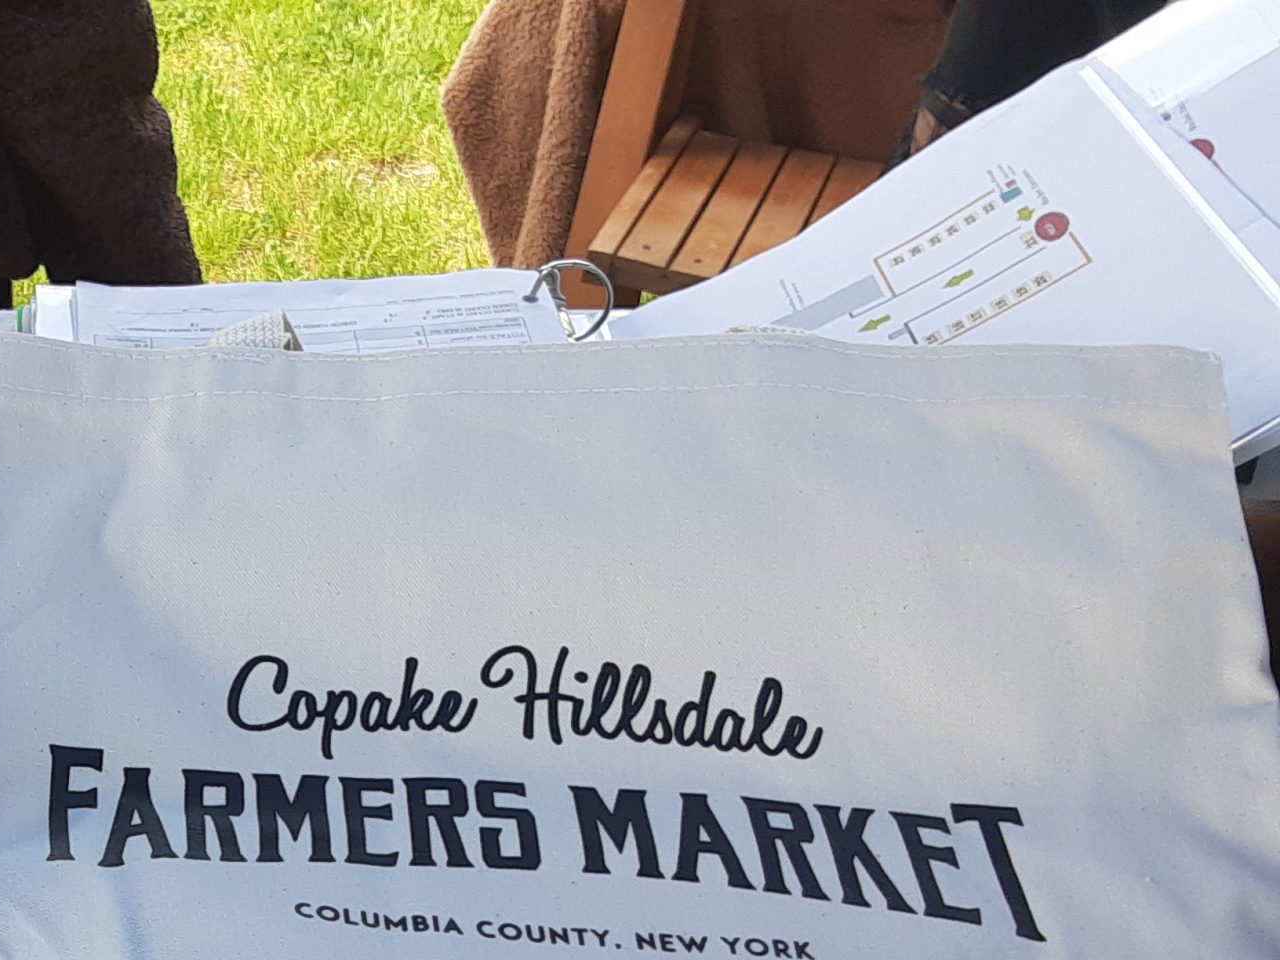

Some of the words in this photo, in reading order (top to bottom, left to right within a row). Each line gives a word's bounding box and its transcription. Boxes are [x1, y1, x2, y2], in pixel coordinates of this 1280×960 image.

[227, 654, 479, 760] Copake
[480, 645, 824, 760] Hillsdale
[46, 744, 543, 871] FARMERS
[567, 784, 1047, 943] MARKET
[294, 902, 464, 936] COLUMBIA
[636, 932, 708, 954] NEW
[721, 936, 816, 960] YORK
